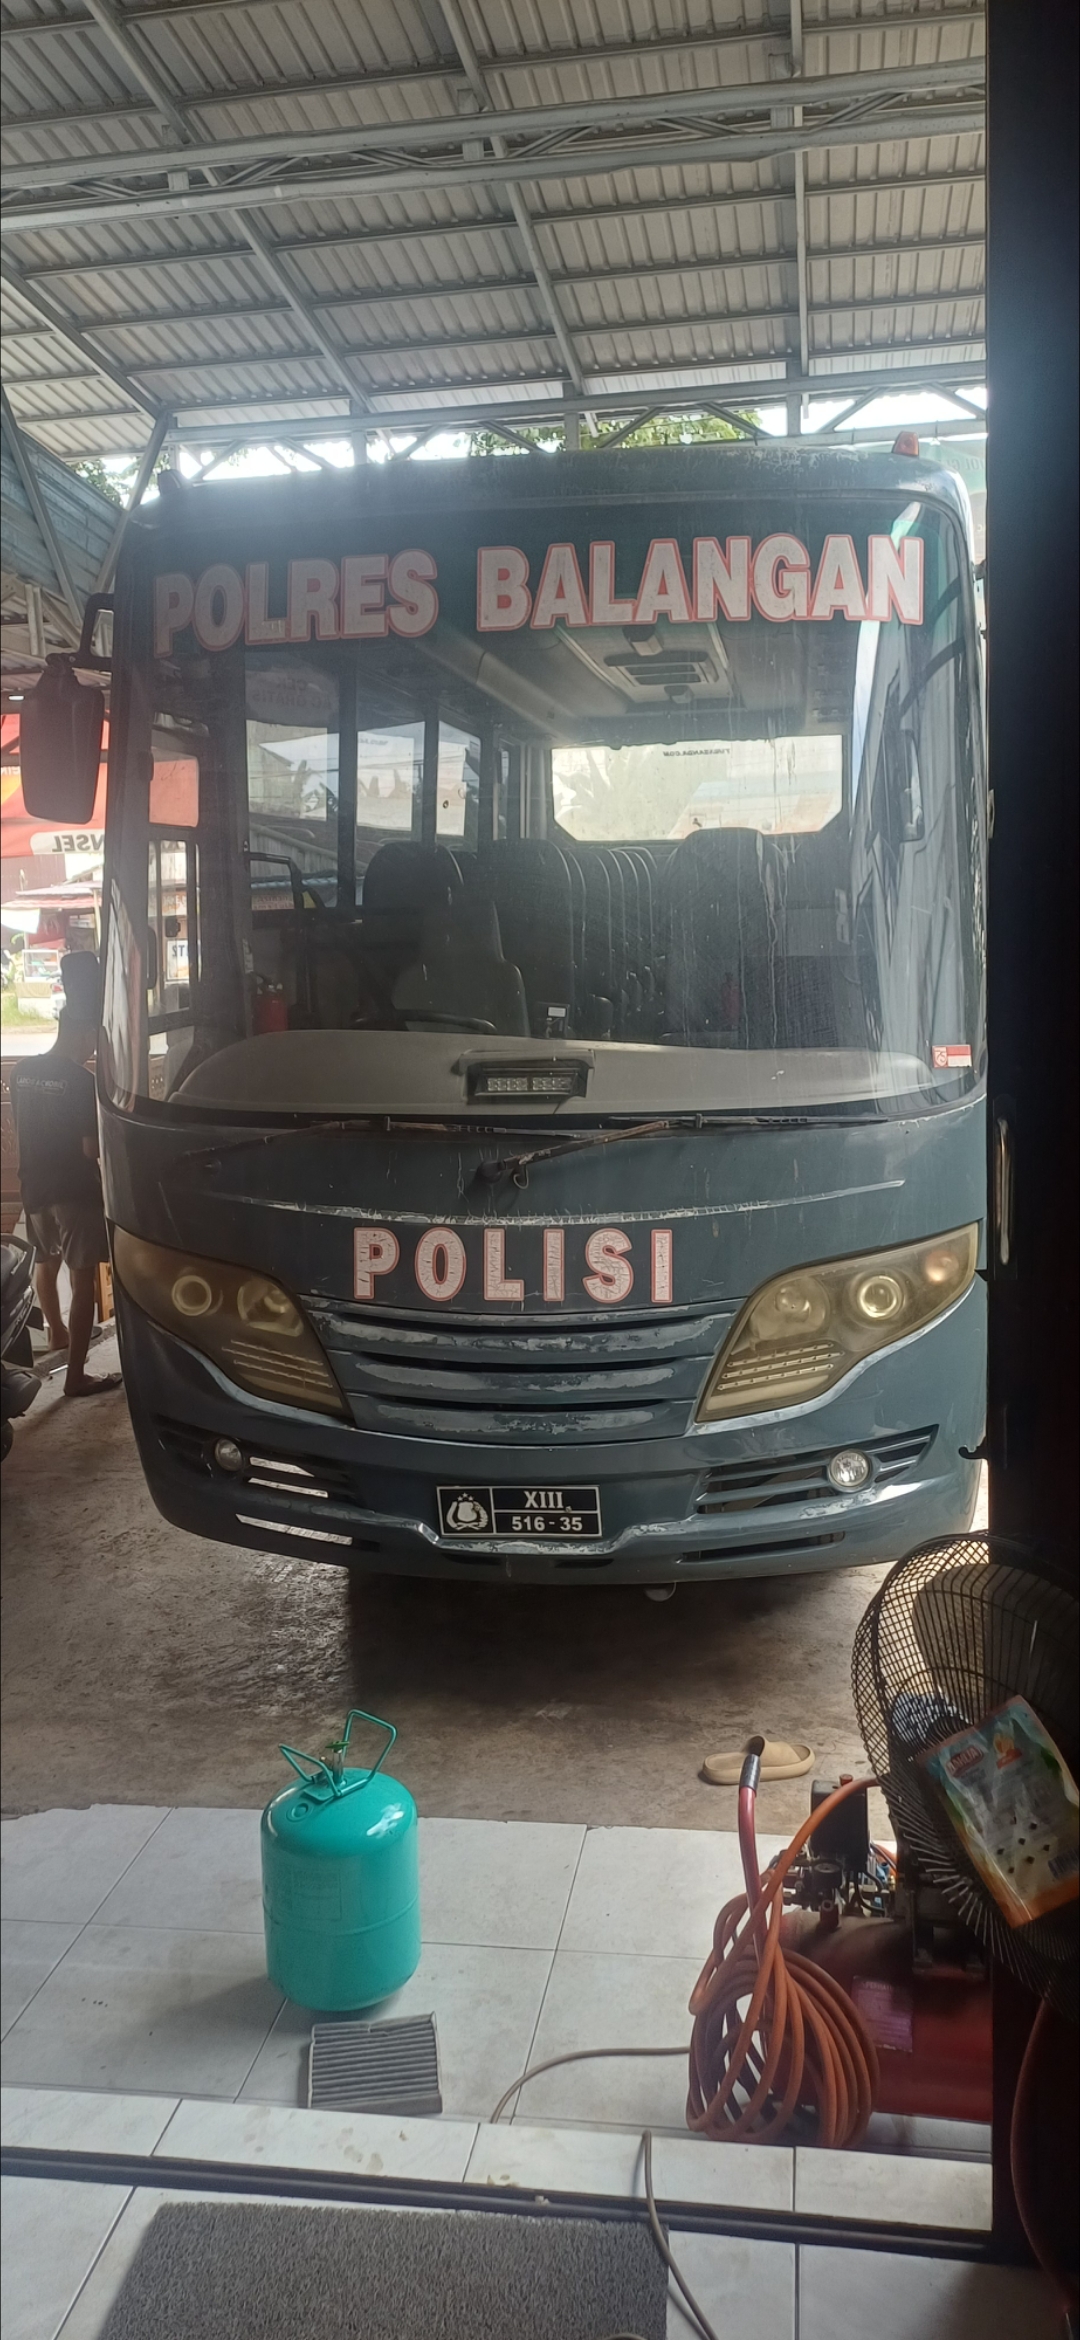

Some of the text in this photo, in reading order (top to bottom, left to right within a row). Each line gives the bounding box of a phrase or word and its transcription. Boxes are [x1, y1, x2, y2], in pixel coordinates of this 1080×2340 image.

[153, 533, 924, 659] POLRES BALANGAN
[353, 1227, 673, 1303] POLISI
[511, 1516, 545, 1531] 516
[560, 1517, 583, 1532] 35
